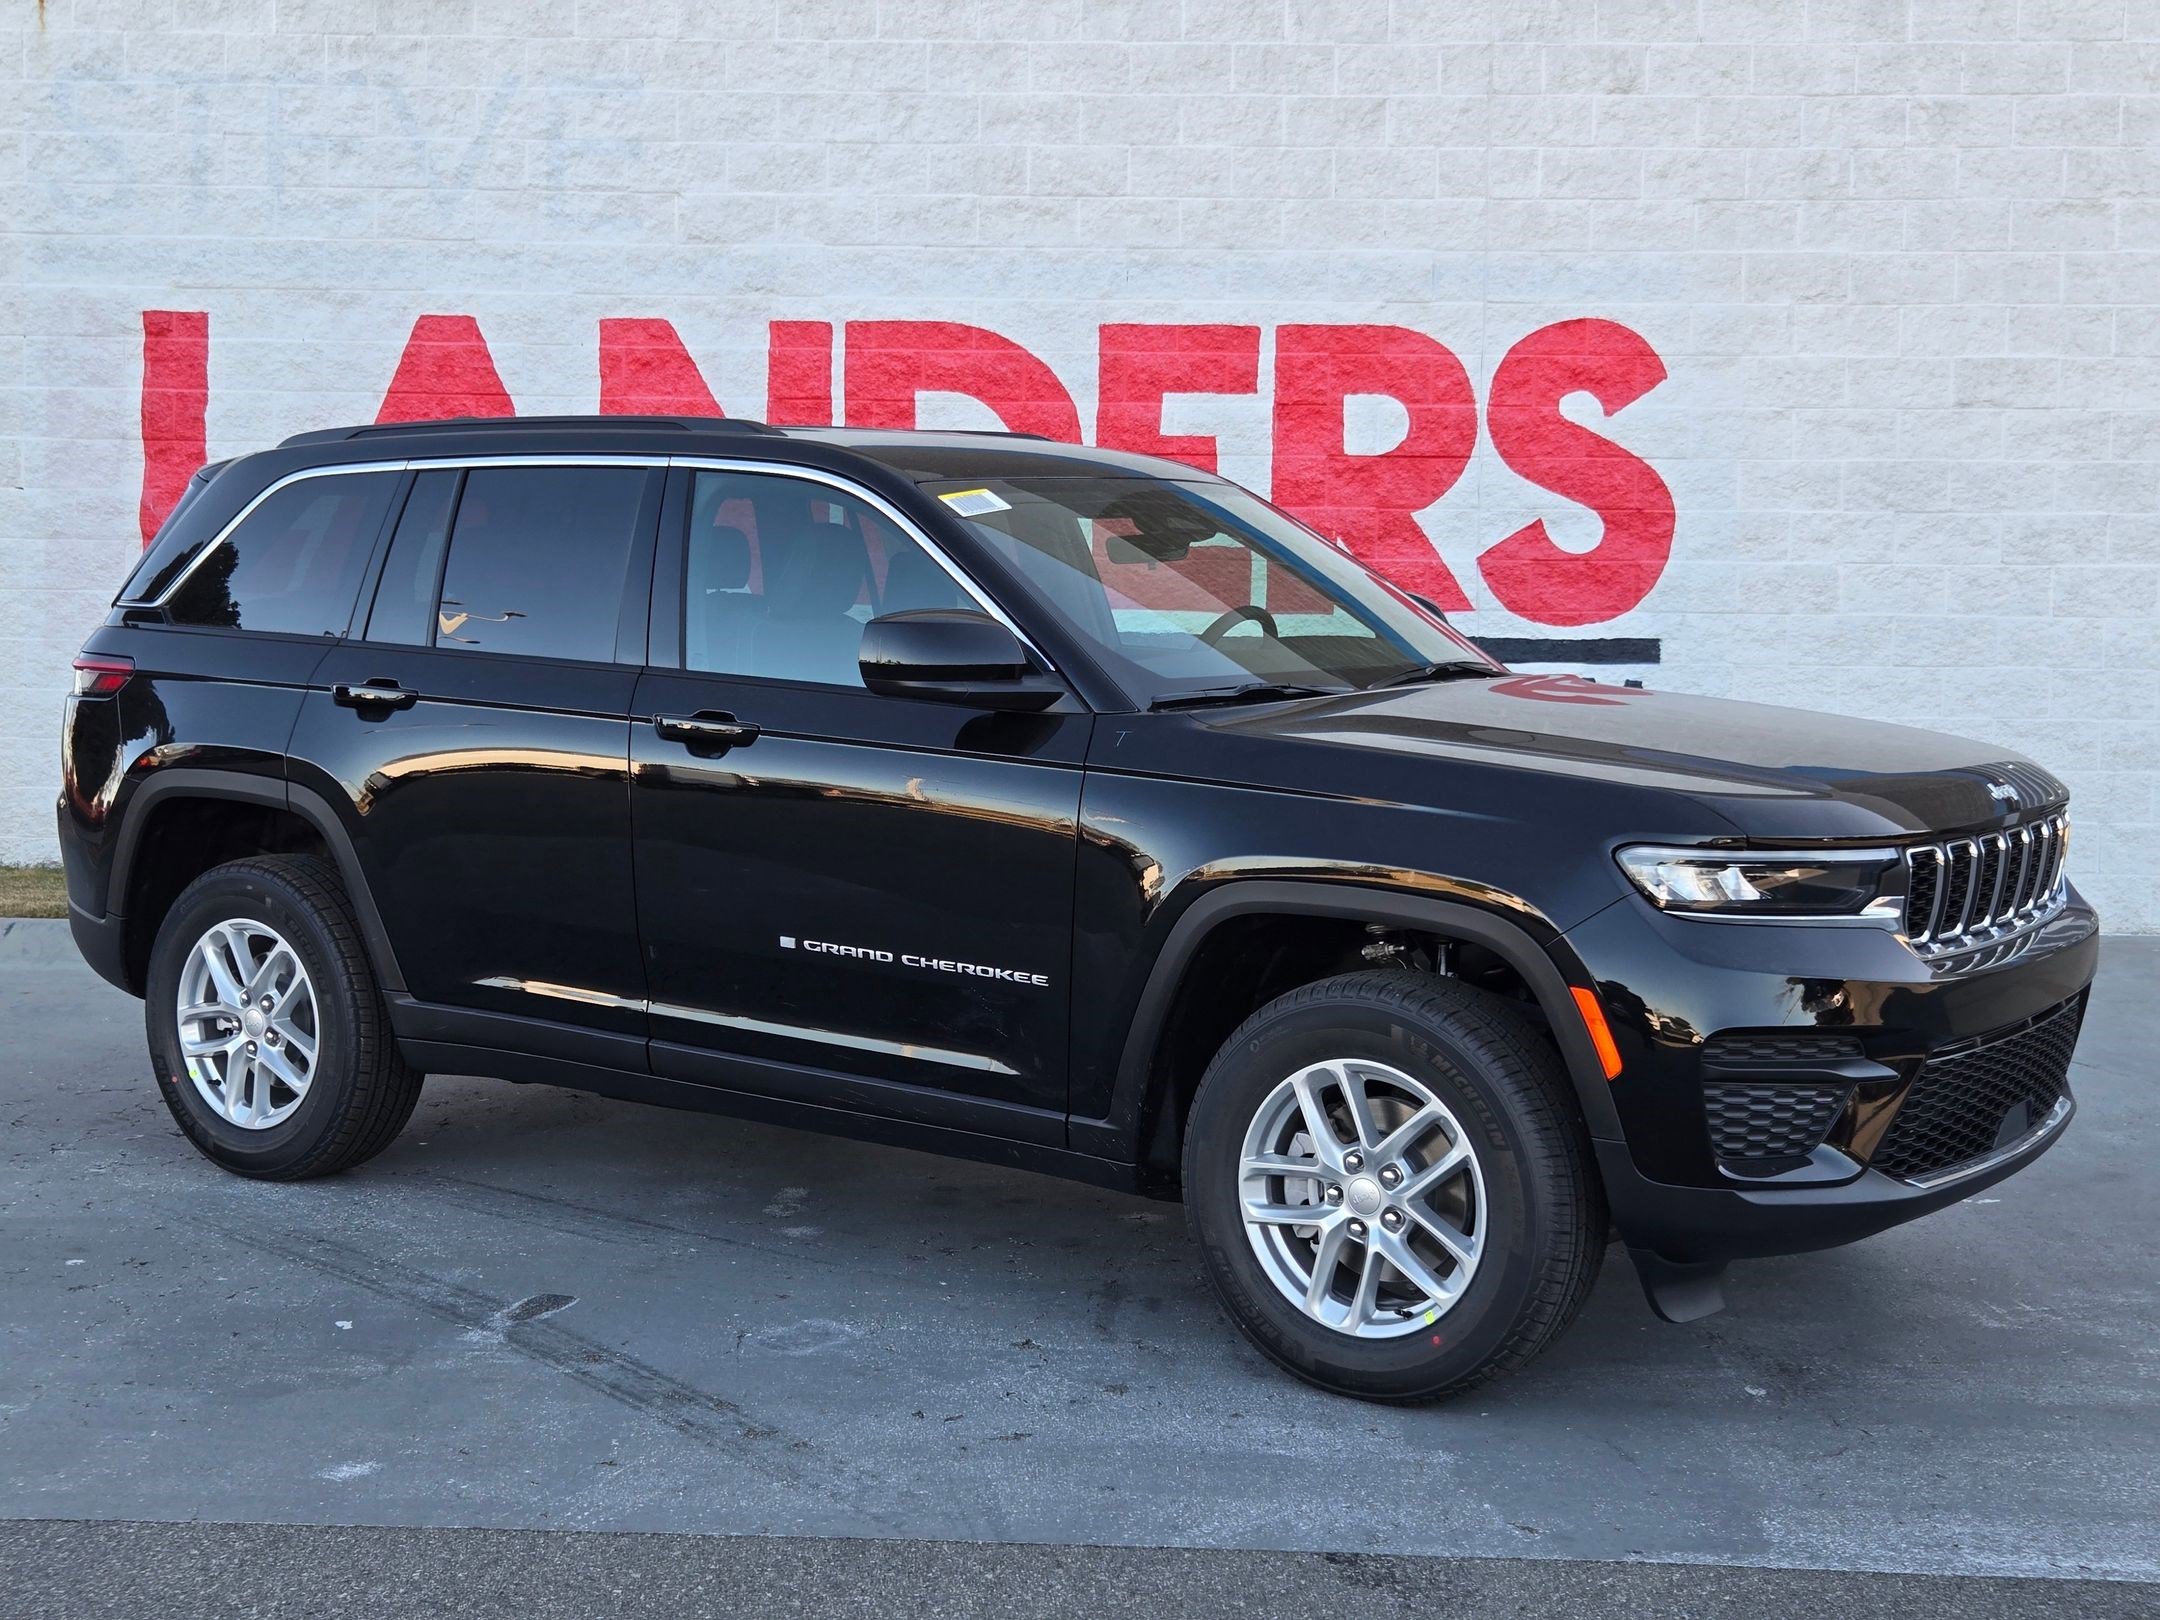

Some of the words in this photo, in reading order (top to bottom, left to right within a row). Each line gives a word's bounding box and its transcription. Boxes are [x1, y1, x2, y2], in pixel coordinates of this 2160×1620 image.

[803, 940, 894, 963] GRAND
[901, 954, 1050, 987] CHEROKEE
[1432, 1056, 1508, 1148] MICHELIN
